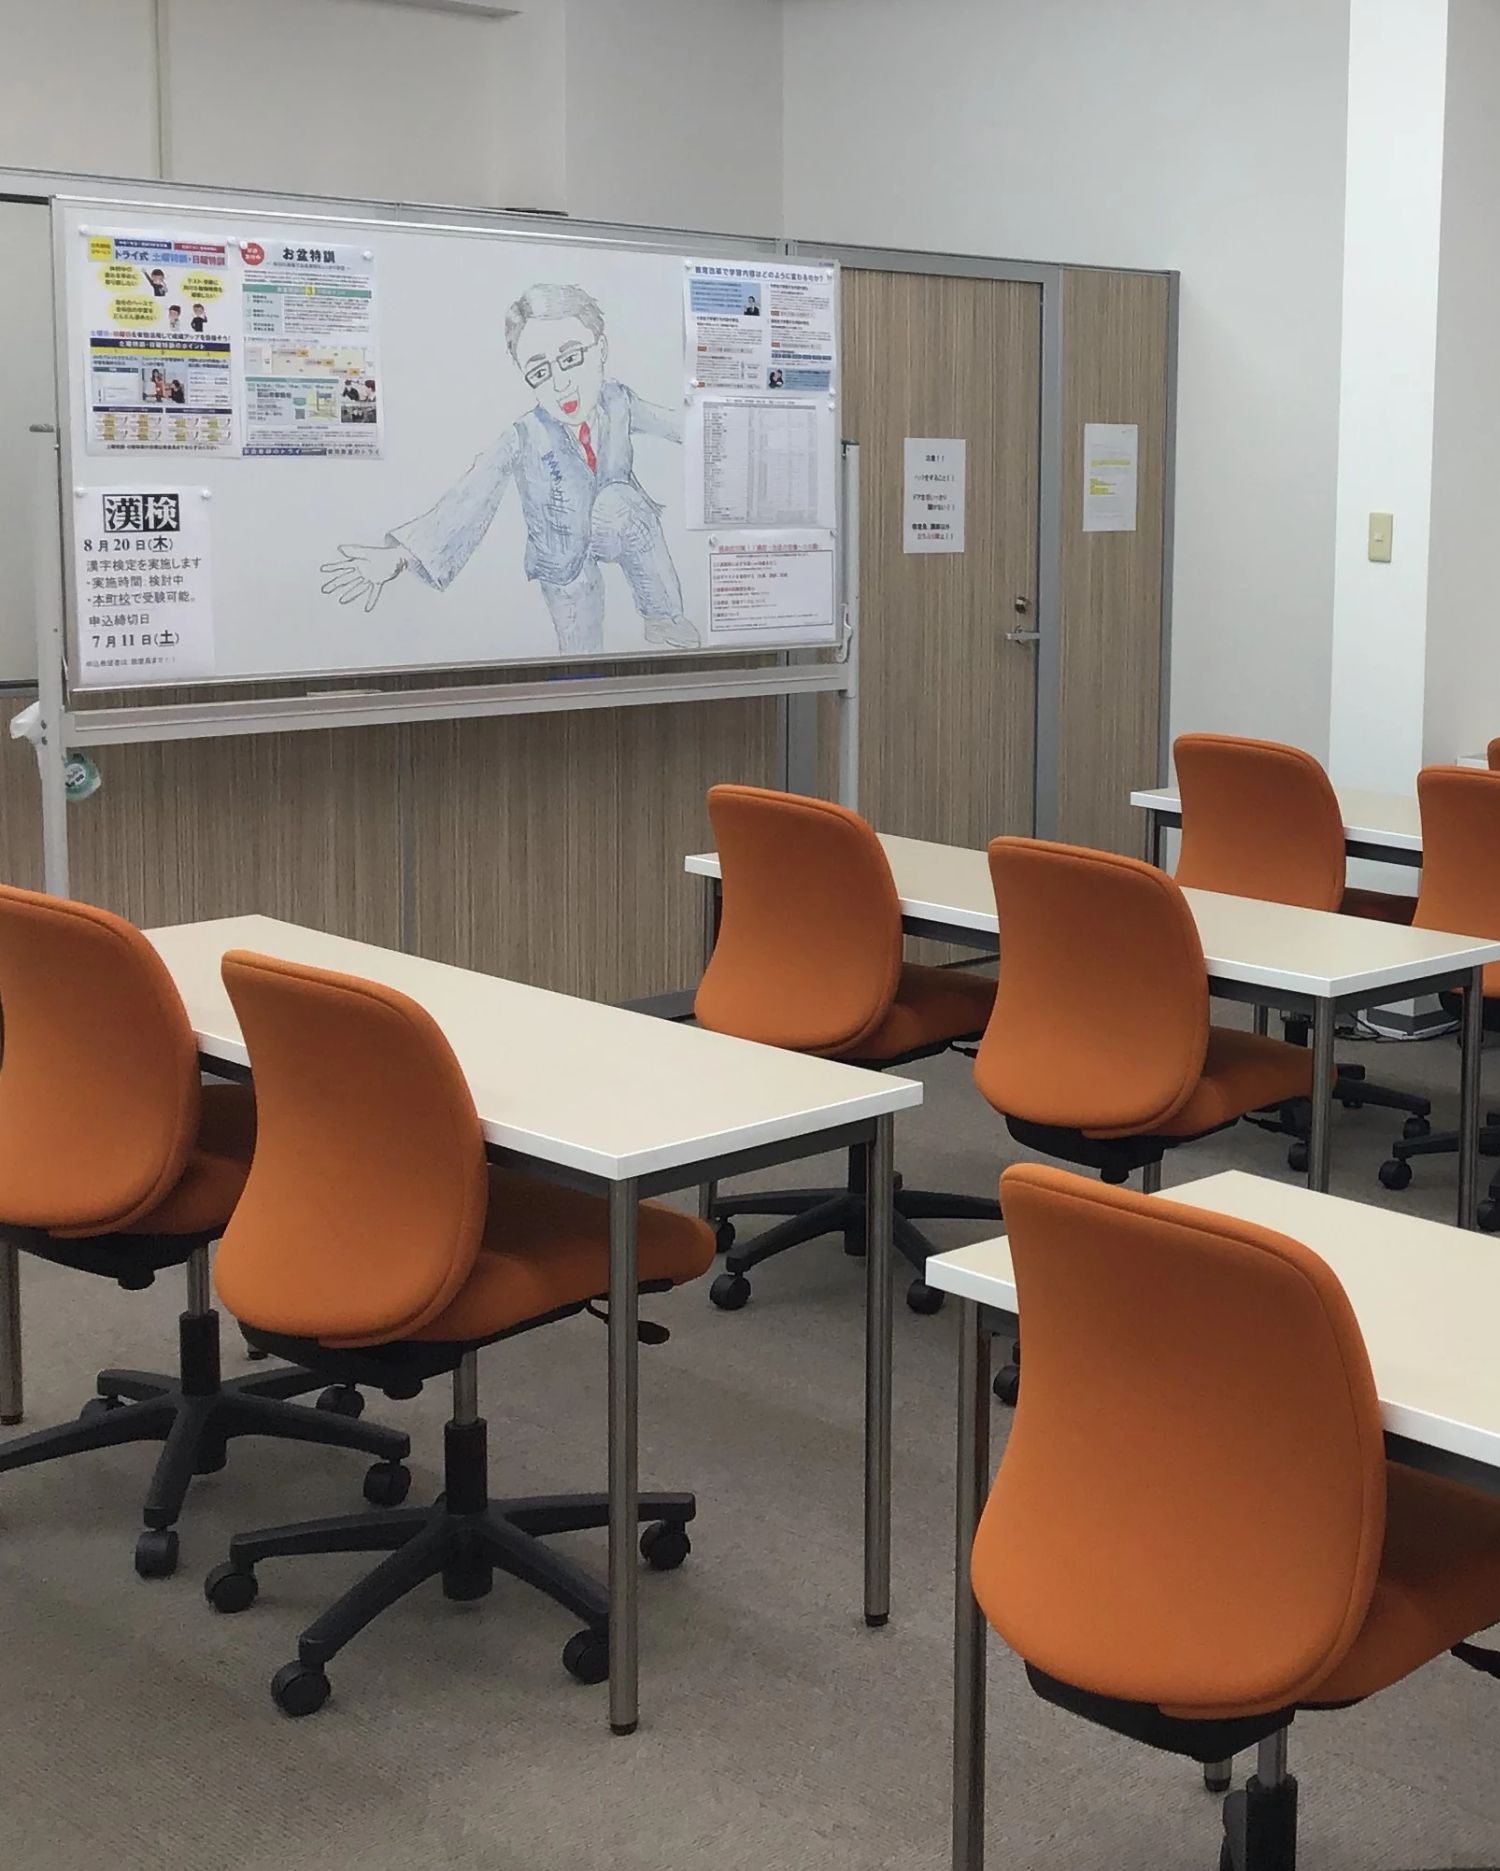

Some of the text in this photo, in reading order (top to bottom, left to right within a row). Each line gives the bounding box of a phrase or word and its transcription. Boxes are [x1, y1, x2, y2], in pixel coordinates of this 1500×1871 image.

[115, 250, 149, 261] トライ式
[282, 247, 336, 263] お盆特訓
[104, 495, 180, 532] 漢検
[86, 556, 202, 572] 漢字検定を実施します
[148, 574, 184, 587] 検討中
[89, 613, 150, 627] 申込締切日
